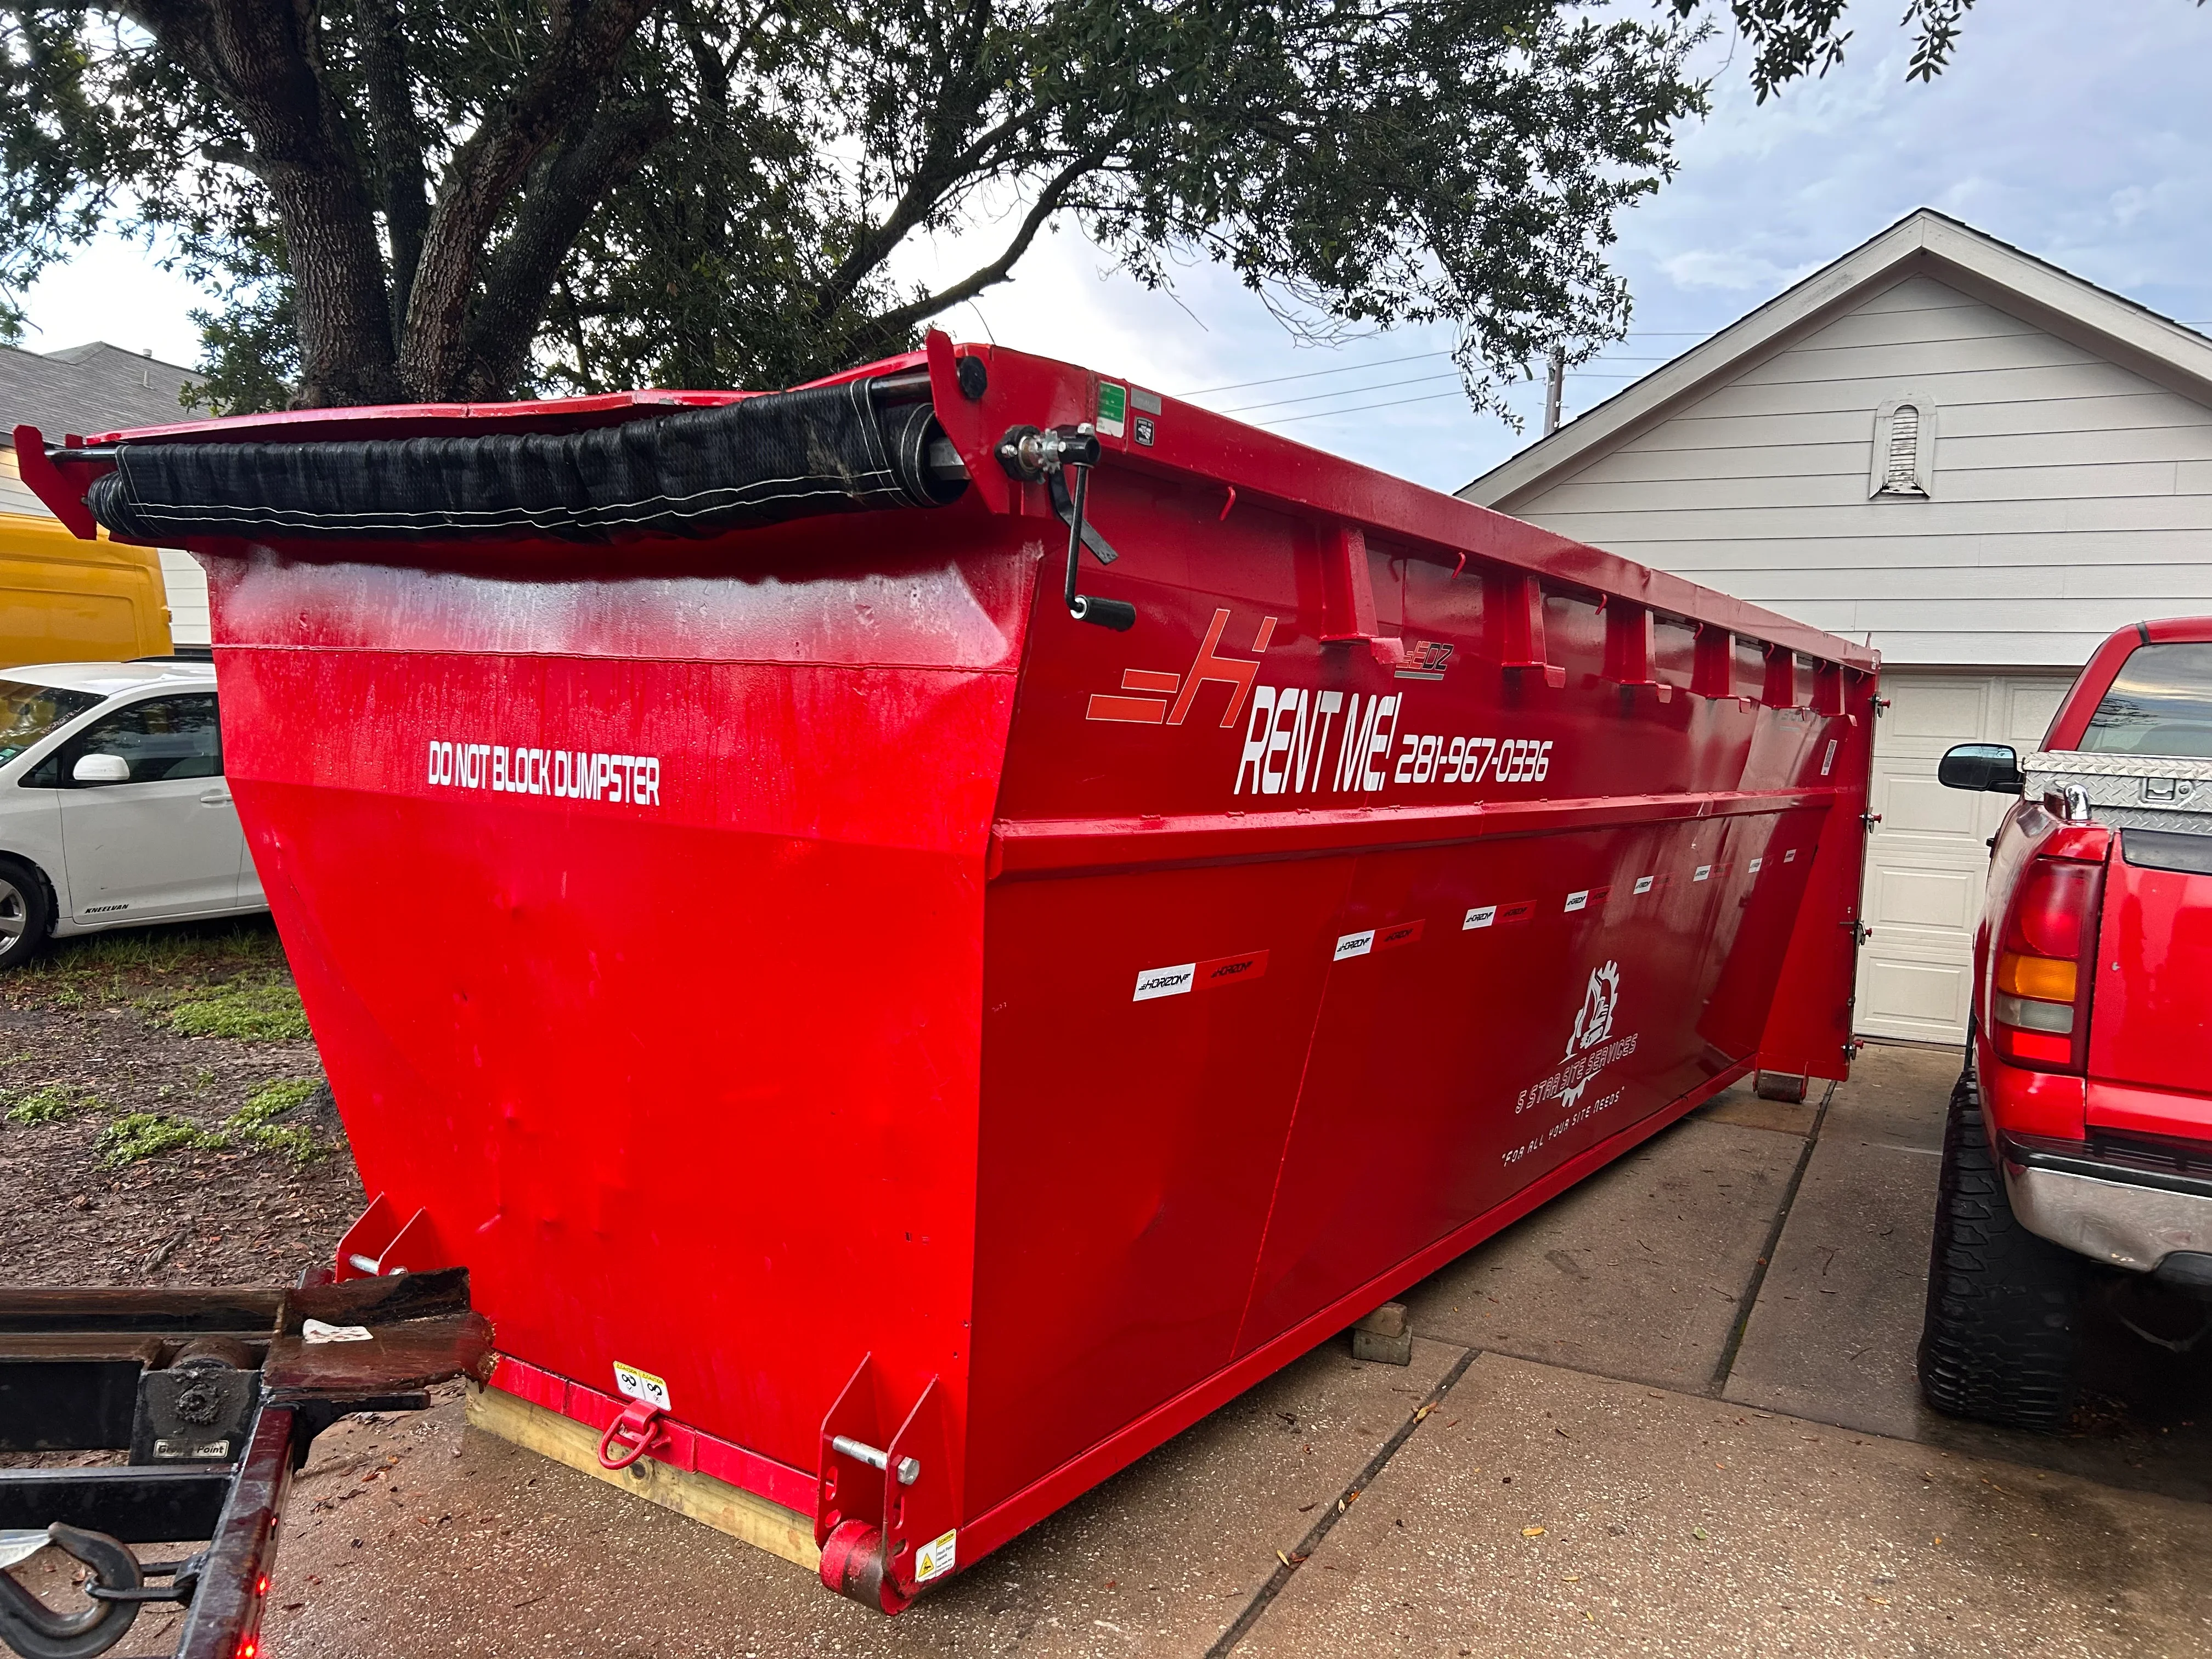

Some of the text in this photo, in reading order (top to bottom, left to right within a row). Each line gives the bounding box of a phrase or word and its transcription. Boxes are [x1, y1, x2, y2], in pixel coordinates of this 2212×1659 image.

[1234, 685, 1553, 794] RENT ME! 281-967-0336
[428, 741, 660, 806] DO NOT BLOCK DUMPSTER
[84, 904, 129, 913] KNEELVAN
[1138, 973, 1190, 991] HORIZON
[1515, 1033, 1638, 1114] 5 STAR SITE SERVICES
[1527, 1135, 1544, 1154] ALL
[1548, 1118, 1570, 1141] YOUR
[1572, 1105, 1592, 1126] SITE
[196, 1446, 224, 1454] Point
